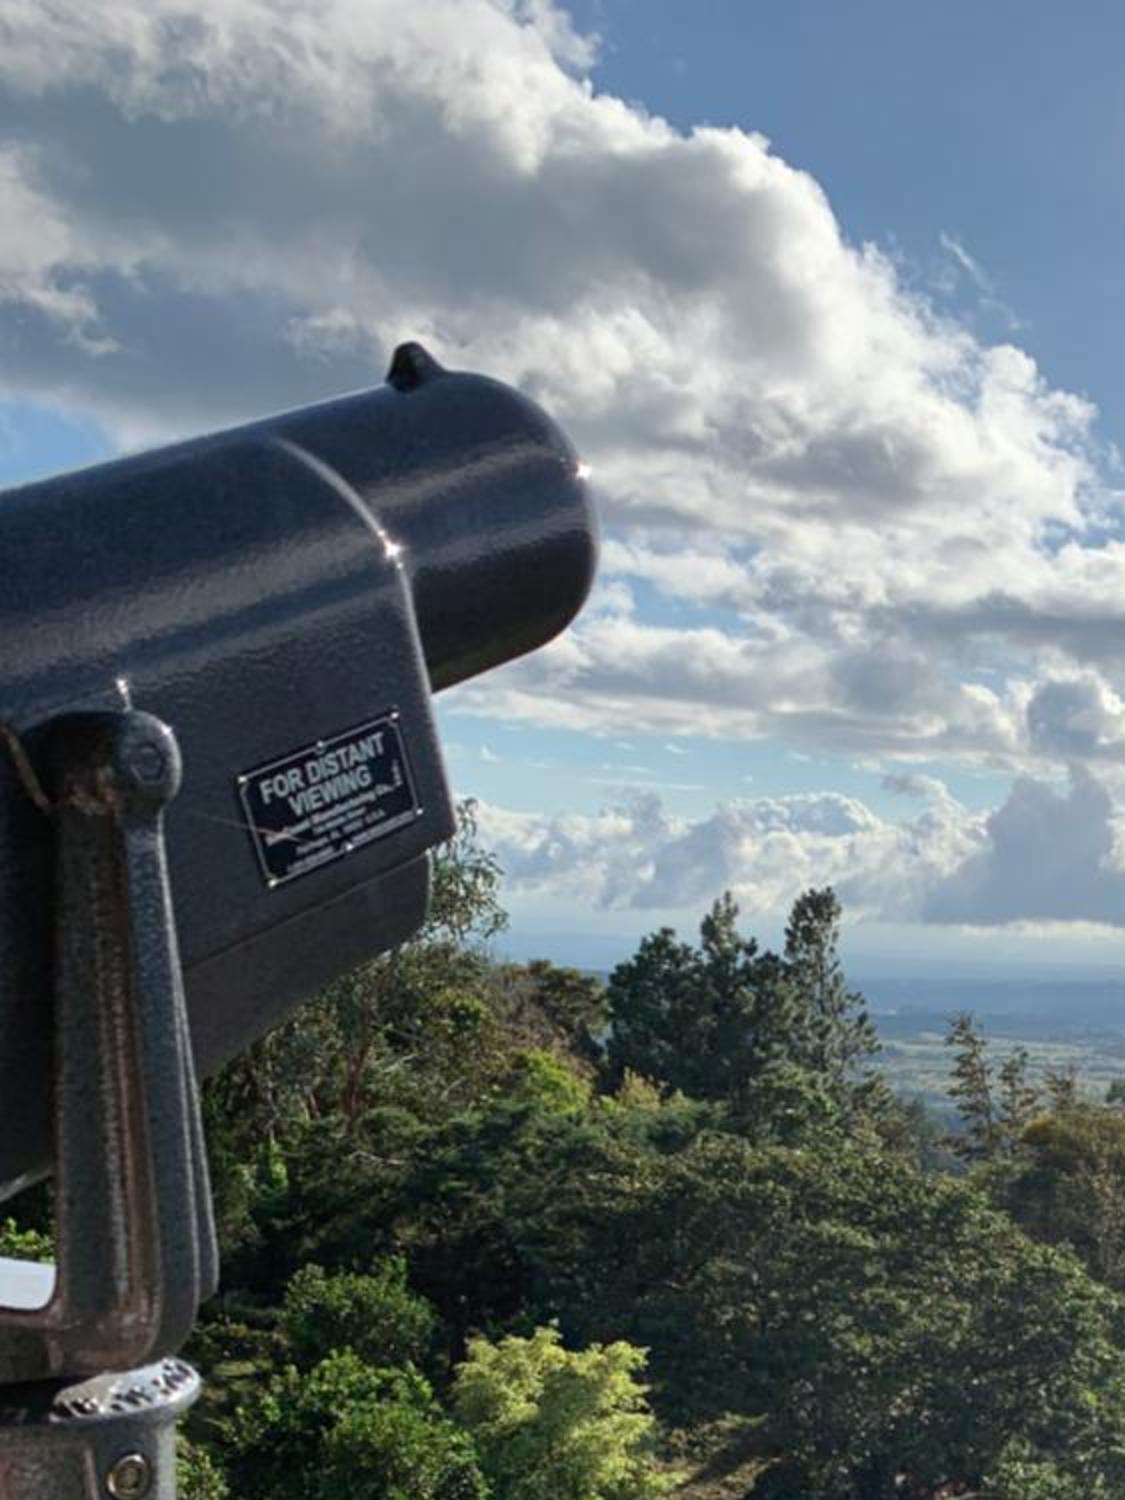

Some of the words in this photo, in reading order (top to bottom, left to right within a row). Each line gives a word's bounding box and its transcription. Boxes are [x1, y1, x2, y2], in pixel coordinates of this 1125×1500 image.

[259, 768, 304, 805] FOR
[306, 732, 385, 779] DISTANT
[288, 765, 372, 816] VIEWING
